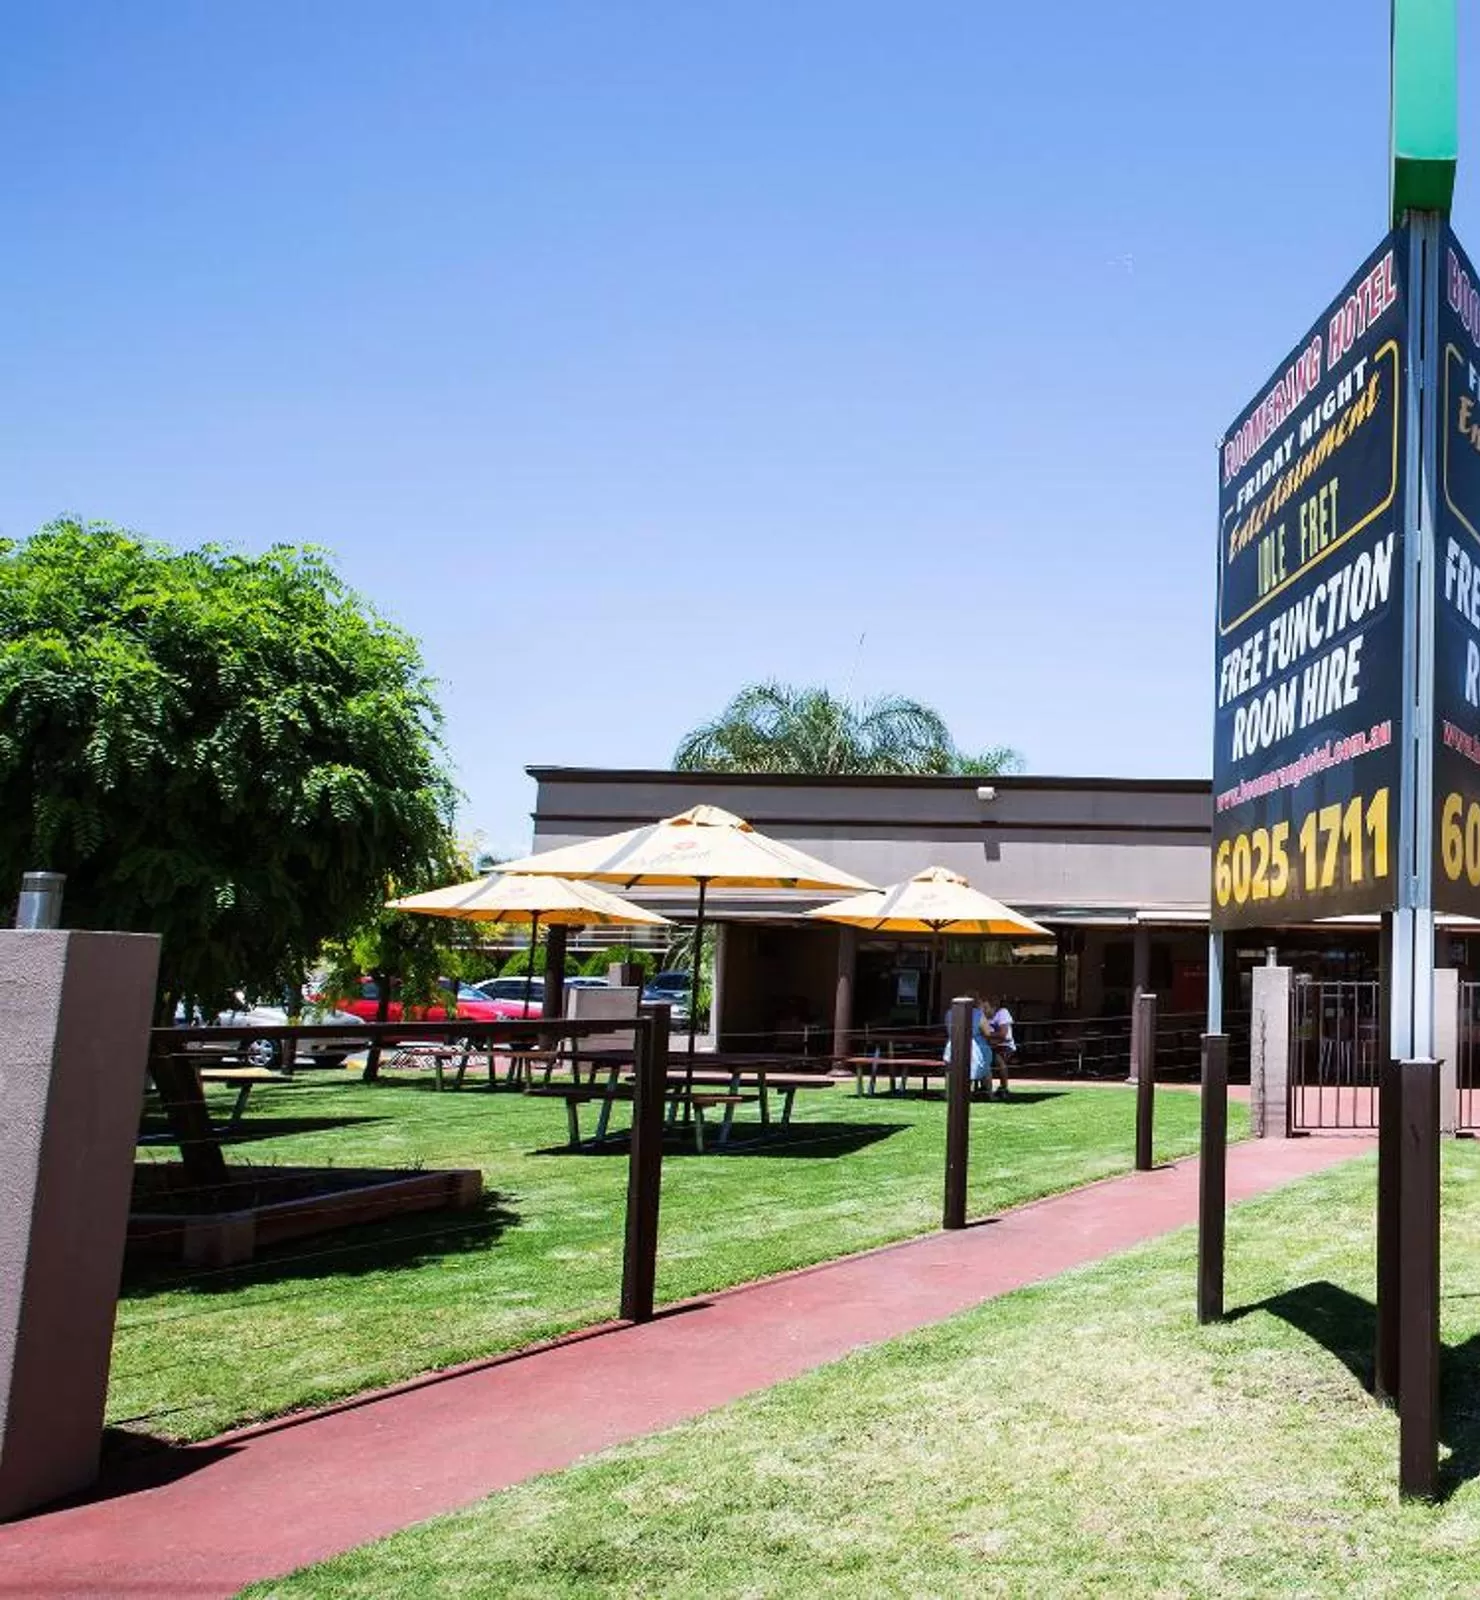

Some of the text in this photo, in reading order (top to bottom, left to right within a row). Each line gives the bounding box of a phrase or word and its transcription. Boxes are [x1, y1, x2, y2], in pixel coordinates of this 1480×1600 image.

[1224, 250, 1397, 487] BOOMERANG HOTEL
[1236, 356, 1368, 513] FRIDAY NIGHT
[1228, 370, 1381, 565] Entertainment
[1300, 476, 1339, 564] FRET
[1219, 531, 1395, 708] FREE FUNCTION
[1232, 634, 1364, 762] ROOM HIRE
[1215, 787, 1390, 906] 6025 1711
